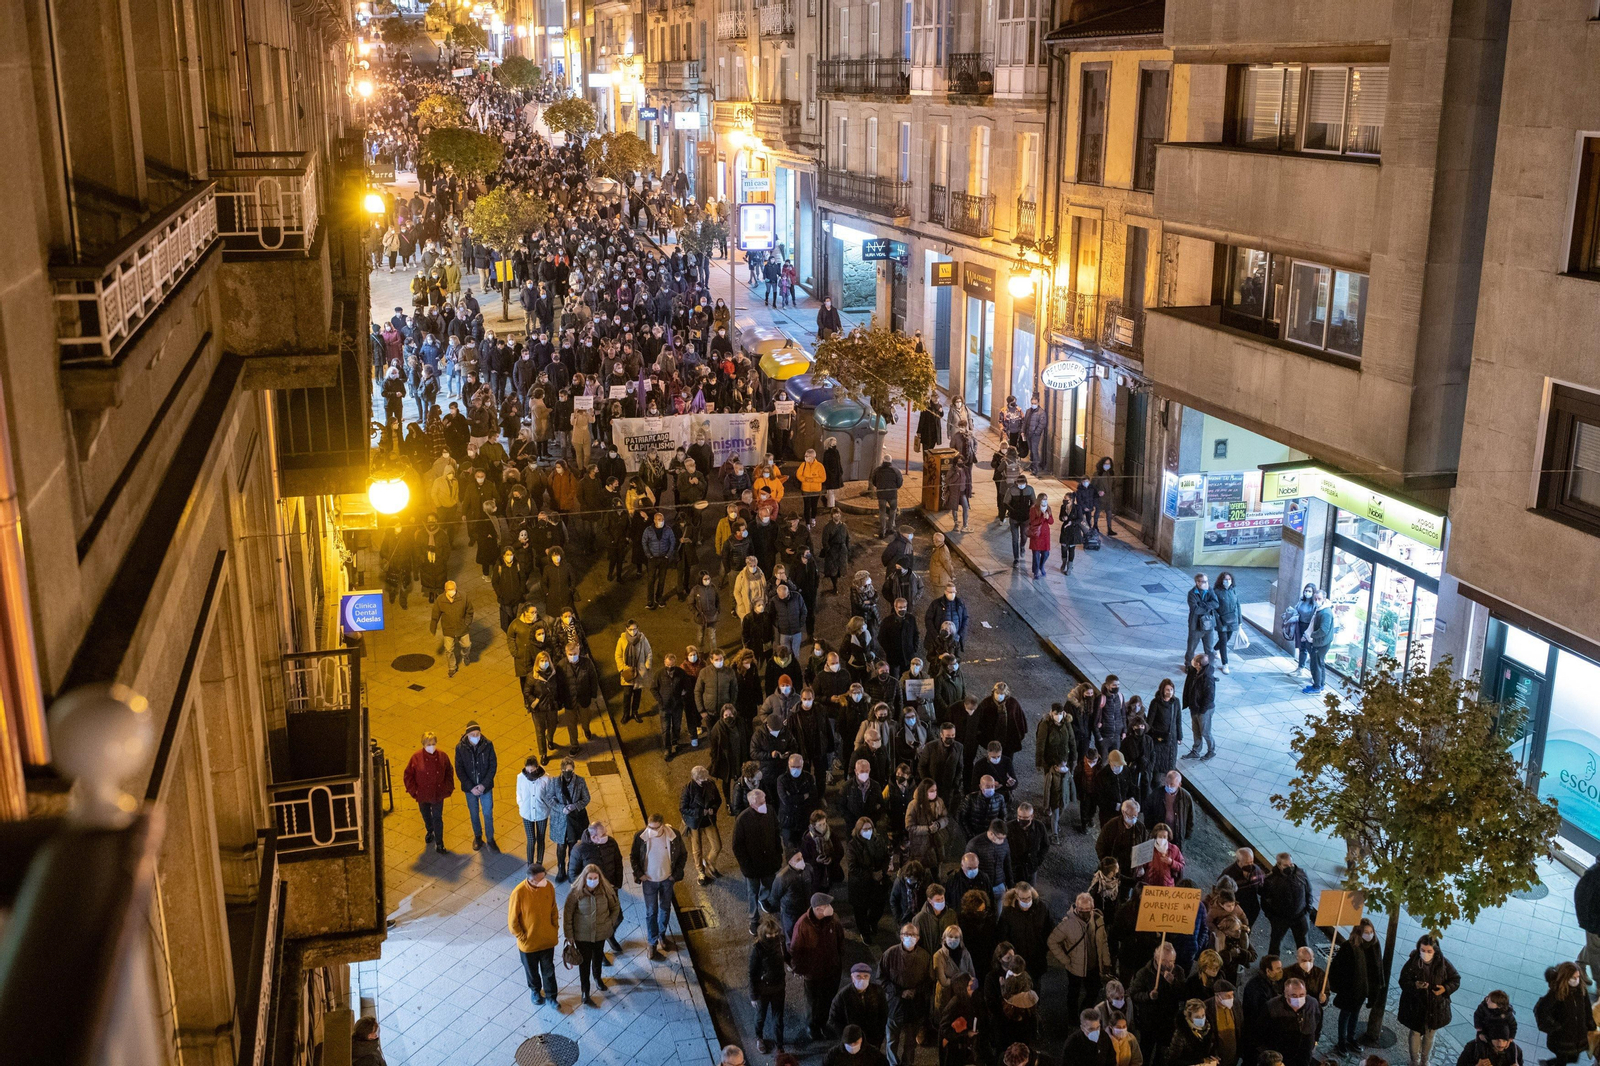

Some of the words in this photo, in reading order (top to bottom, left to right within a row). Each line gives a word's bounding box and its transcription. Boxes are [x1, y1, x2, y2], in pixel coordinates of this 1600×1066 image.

[1046, 377, 1083, 389] MODERNA
[625, 433, 669, 445] PATRIARCADO
[629, 441, 675, 451] CAPITALISMO
[1279, 486, 1297, 495] Nobel
[1368, 508, 1383, 520] Nobel
[1234, 520, 1250, 528] 649
[1560, 769, 1600, 803] esco
[1143, 902, 1179, 910] OURENSE
[1183, 903, 1194, 911] VAI
[1149, 913, 1155, 922] A
[1162, 913, 1188, 924] PIQUE
